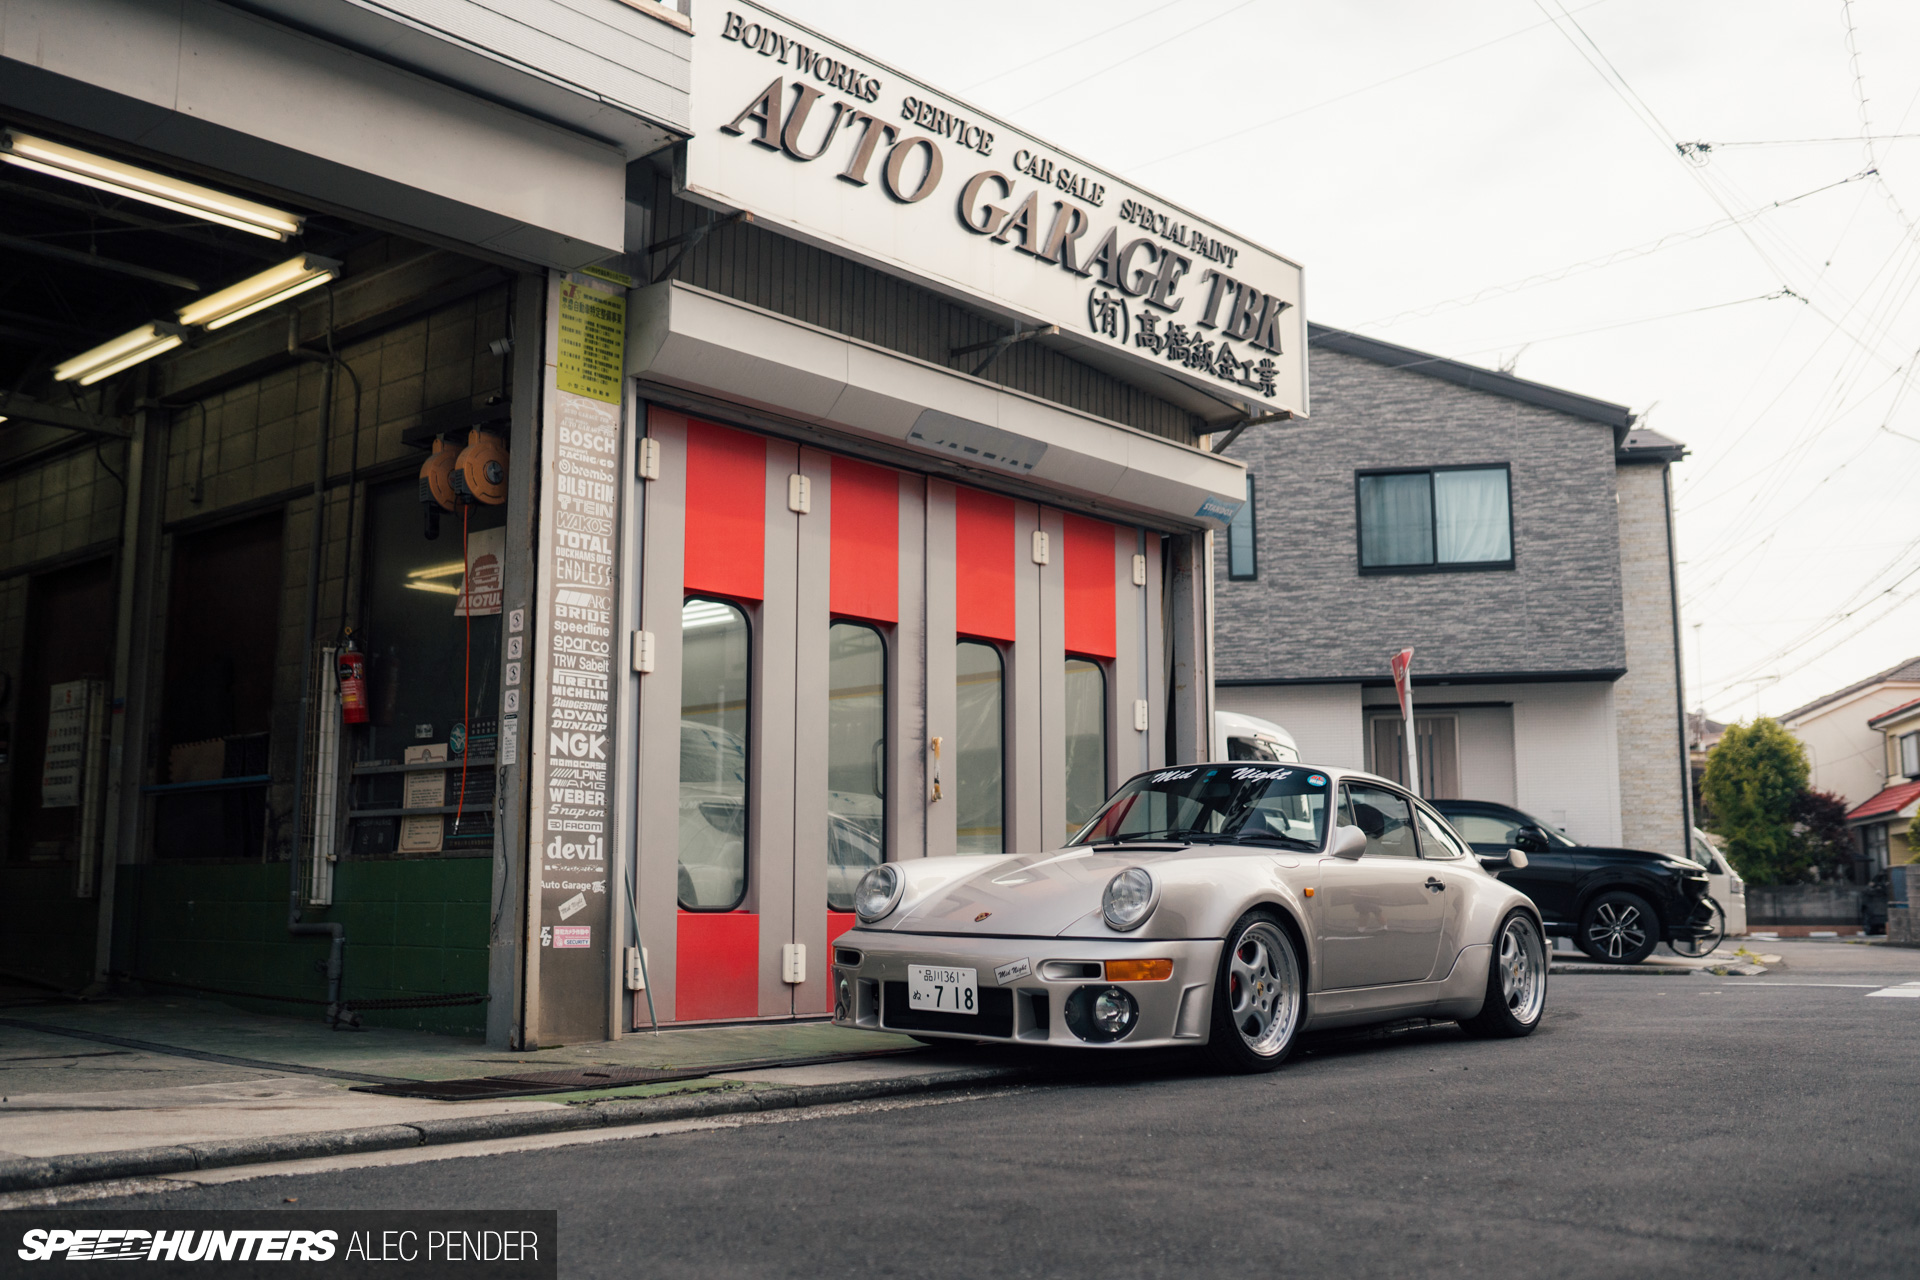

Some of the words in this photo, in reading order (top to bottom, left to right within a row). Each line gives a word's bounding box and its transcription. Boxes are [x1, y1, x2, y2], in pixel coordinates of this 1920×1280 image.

[901, 96, 995, 156] SERVICE
[1013, 149, 1056, 184] CAR
[1056, 168, 1105, 207] SALE
[1119, 198, 1190, 248] SPECIAL
[1190, 230, 1238, 269] PAINT
[720, 76, 943, 204] AUTO
[956, 170, 1192, 312] GARAGE
[1198, 268, 1293, 355] TBK
[560, 426, 615, 454] BOSCH
[571, 462, 614, 483] brembo
[557, 474, 614, 503] BILSTEIN
[573, 497, 613, 518] TEIN
[556, 528, 612, 555] TOTAL
[556, 546, 595, 563] DUCKHAMS
[596, 554, 612, 566] OILS
[556, 557, 611, 586] ENDLESS
[458, 591, 502, 608] MOTUL
[588, 595, 611, 610] ARC
[555, 604, 610, 623] BRIDE
[554, 620, 610, 637] speedline
[554, 635, 609, 654] sparco
[553, 653, 577, 668] TRW
[579, 656, 609, 672] Sabelt
[553, 668, 608, 690] PIRELLI
[552, 685, 608, 701] MICHELIN
[552, 696, 608, 712] BRIDGESTONE
[551, 708, 608, 723] ADVAN
[551, 719, 608, 733] DUNLOP
[550, 731, 606, 760] NGK
[568, 769, 606, 781] ALPINE
[1152, 768, 1198, 783] Mid
[1231, 767, 1293, 783] Night
[567, 780, 606, 790] AMG
[549, 788, 605, 806] WEBER
[565, 822, 601, 831] FACOM
[547, 834, 603, 860] devil
[541, 881, 560, 889] Auto
[562, 880, 591, 891] Garage
[998, 969, 1010, 978] Mid
